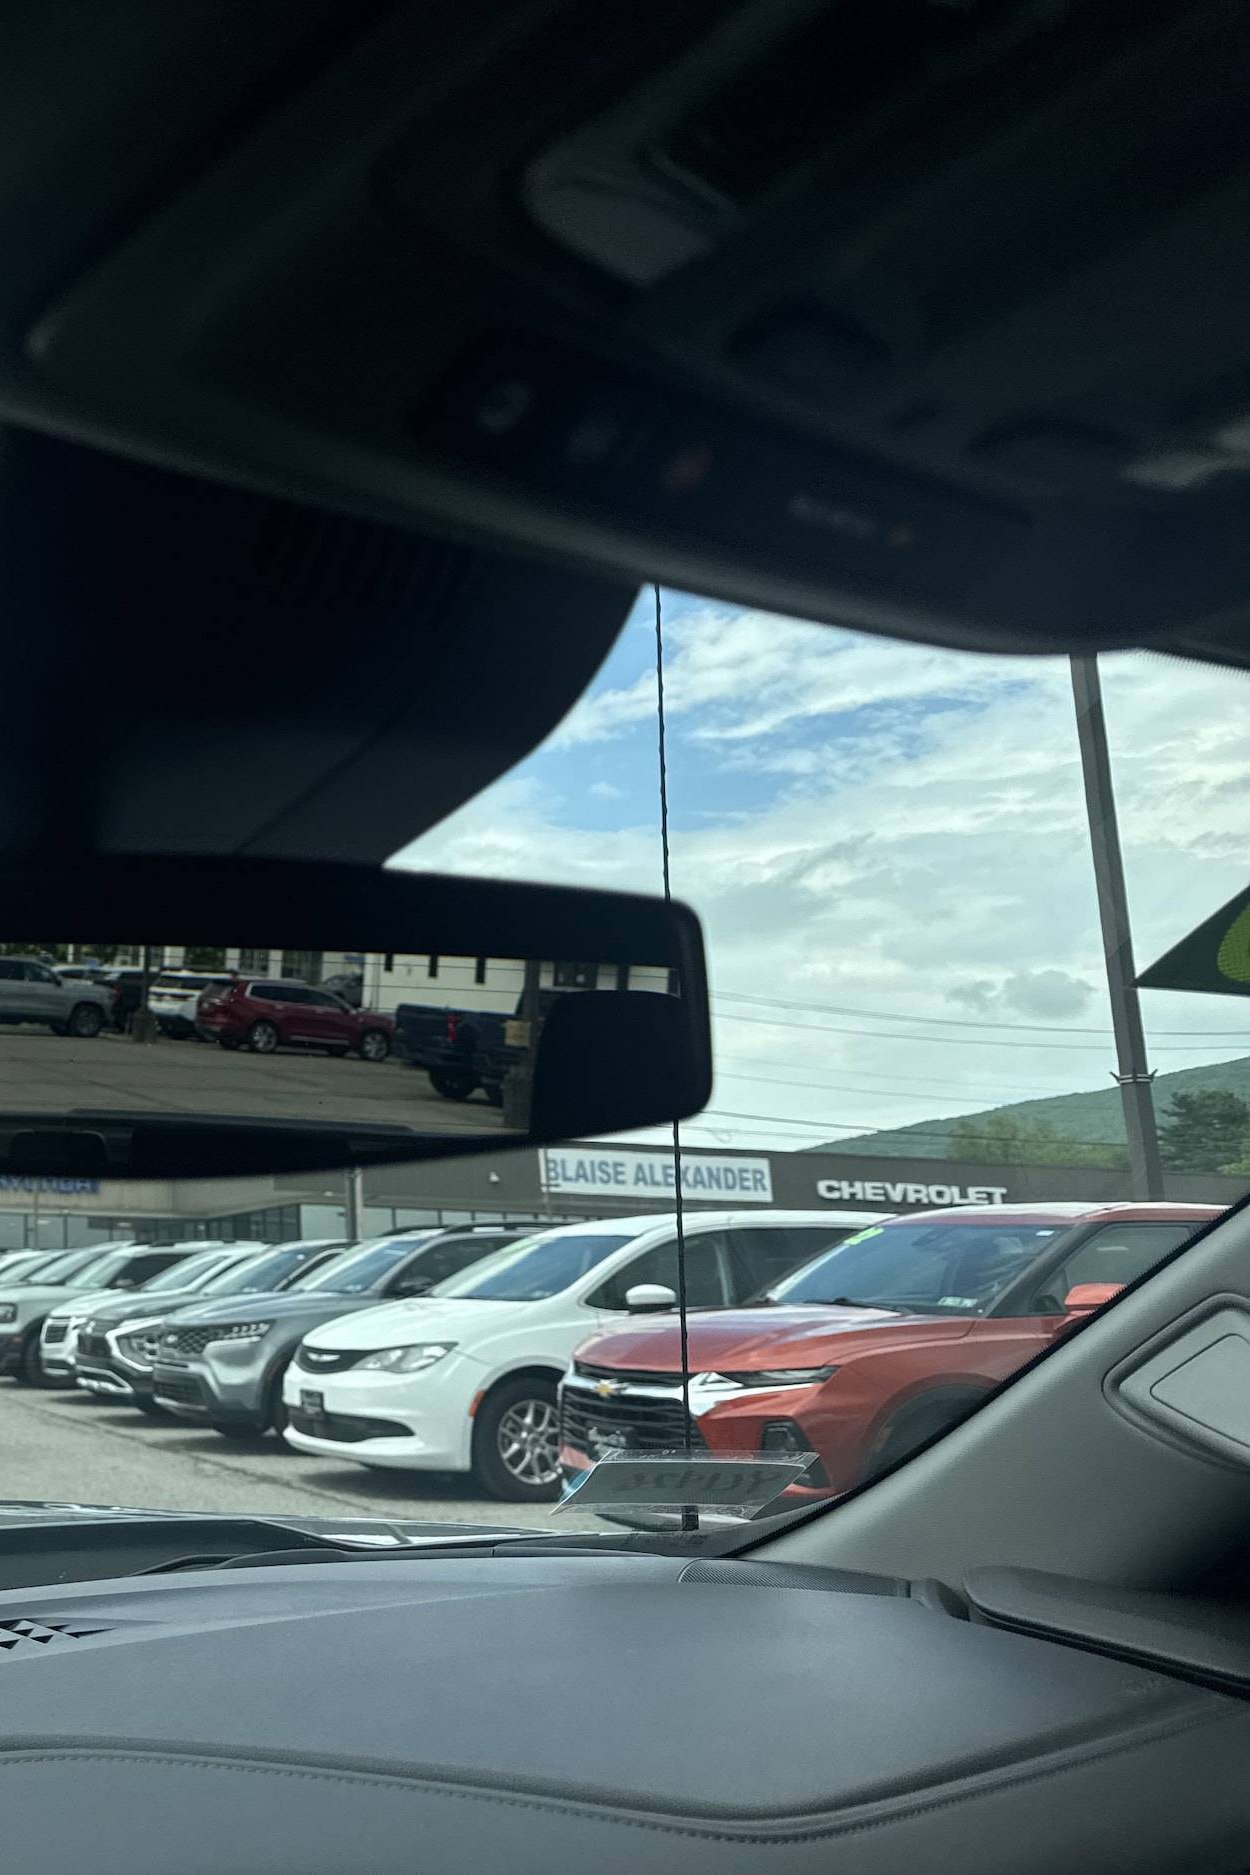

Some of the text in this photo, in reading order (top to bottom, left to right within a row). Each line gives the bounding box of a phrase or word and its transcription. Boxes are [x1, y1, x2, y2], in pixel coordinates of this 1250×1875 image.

[547, 1157, 768, 1192] BLAISE ALEXANDER
[817, 1179, 1007, 1205] CHEVROLET
